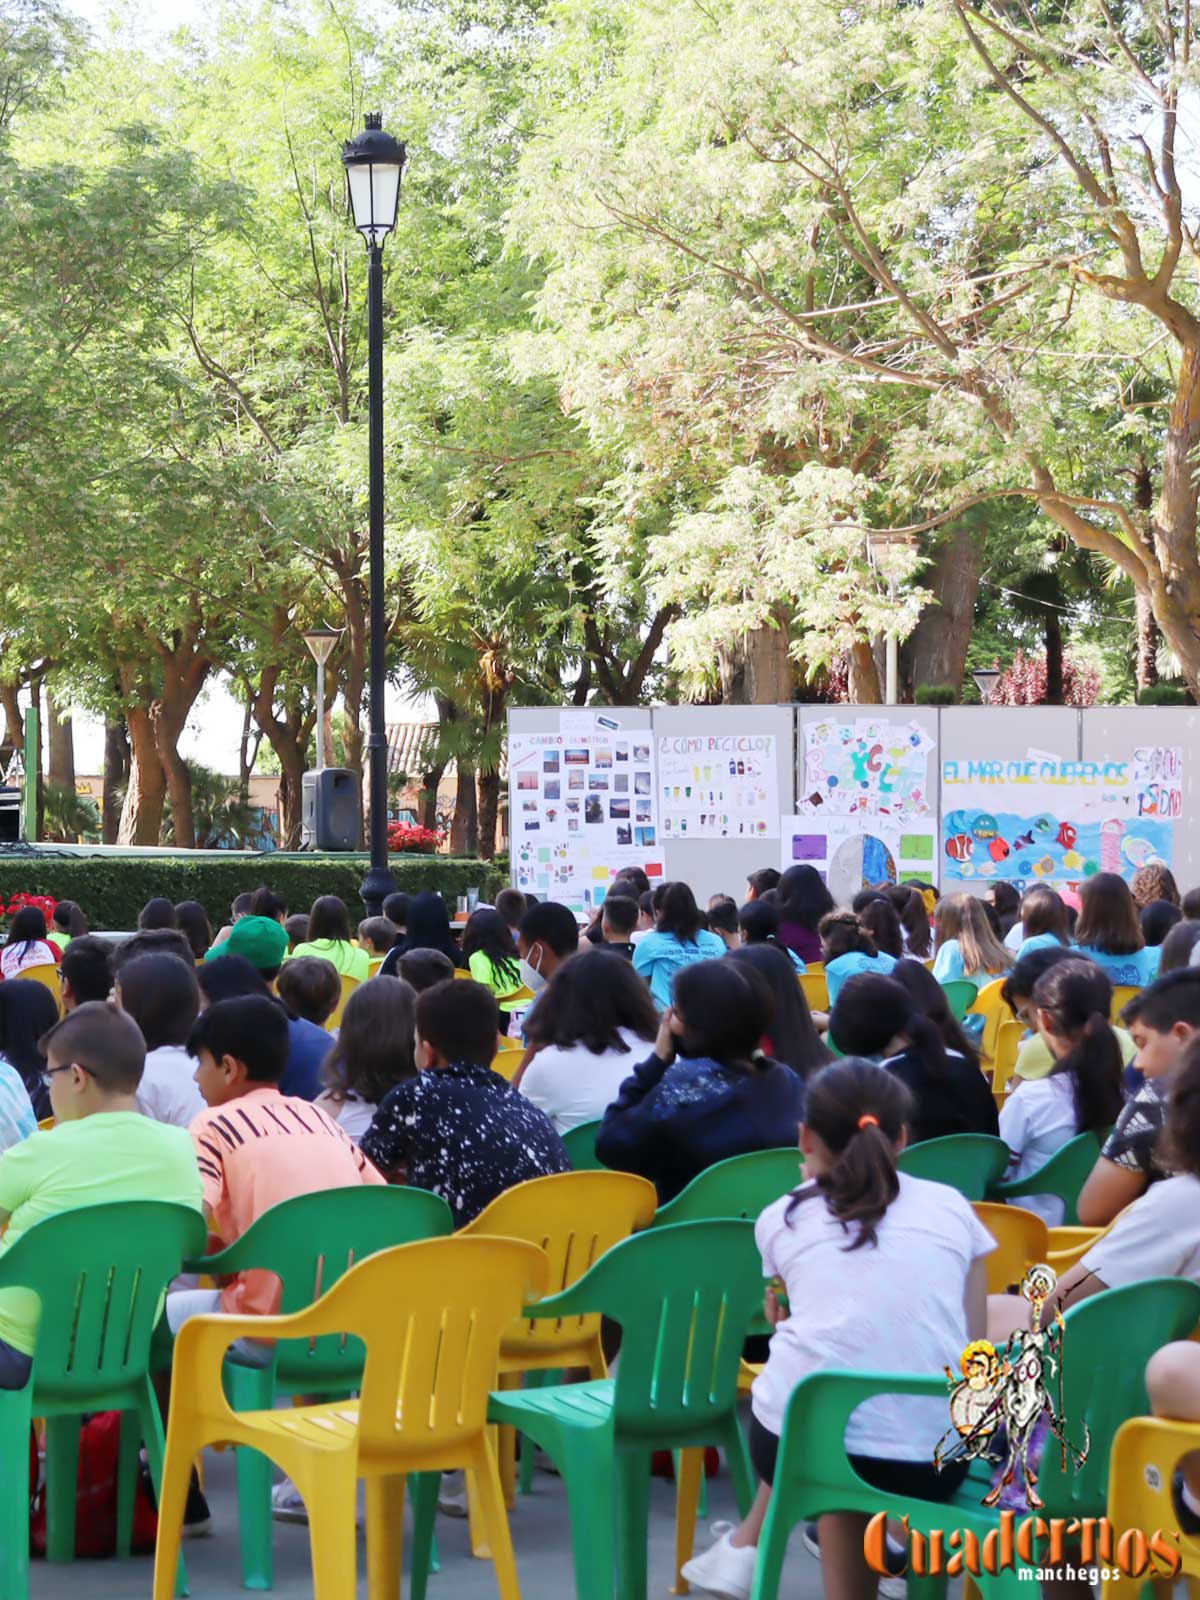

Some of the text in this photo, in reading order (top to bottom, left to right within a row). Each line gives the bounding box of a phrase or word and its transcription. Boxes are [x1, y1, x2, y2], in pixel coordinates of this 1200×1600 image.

[943, 761, 1130, 786] EL MAR QUE QUEREMOS
